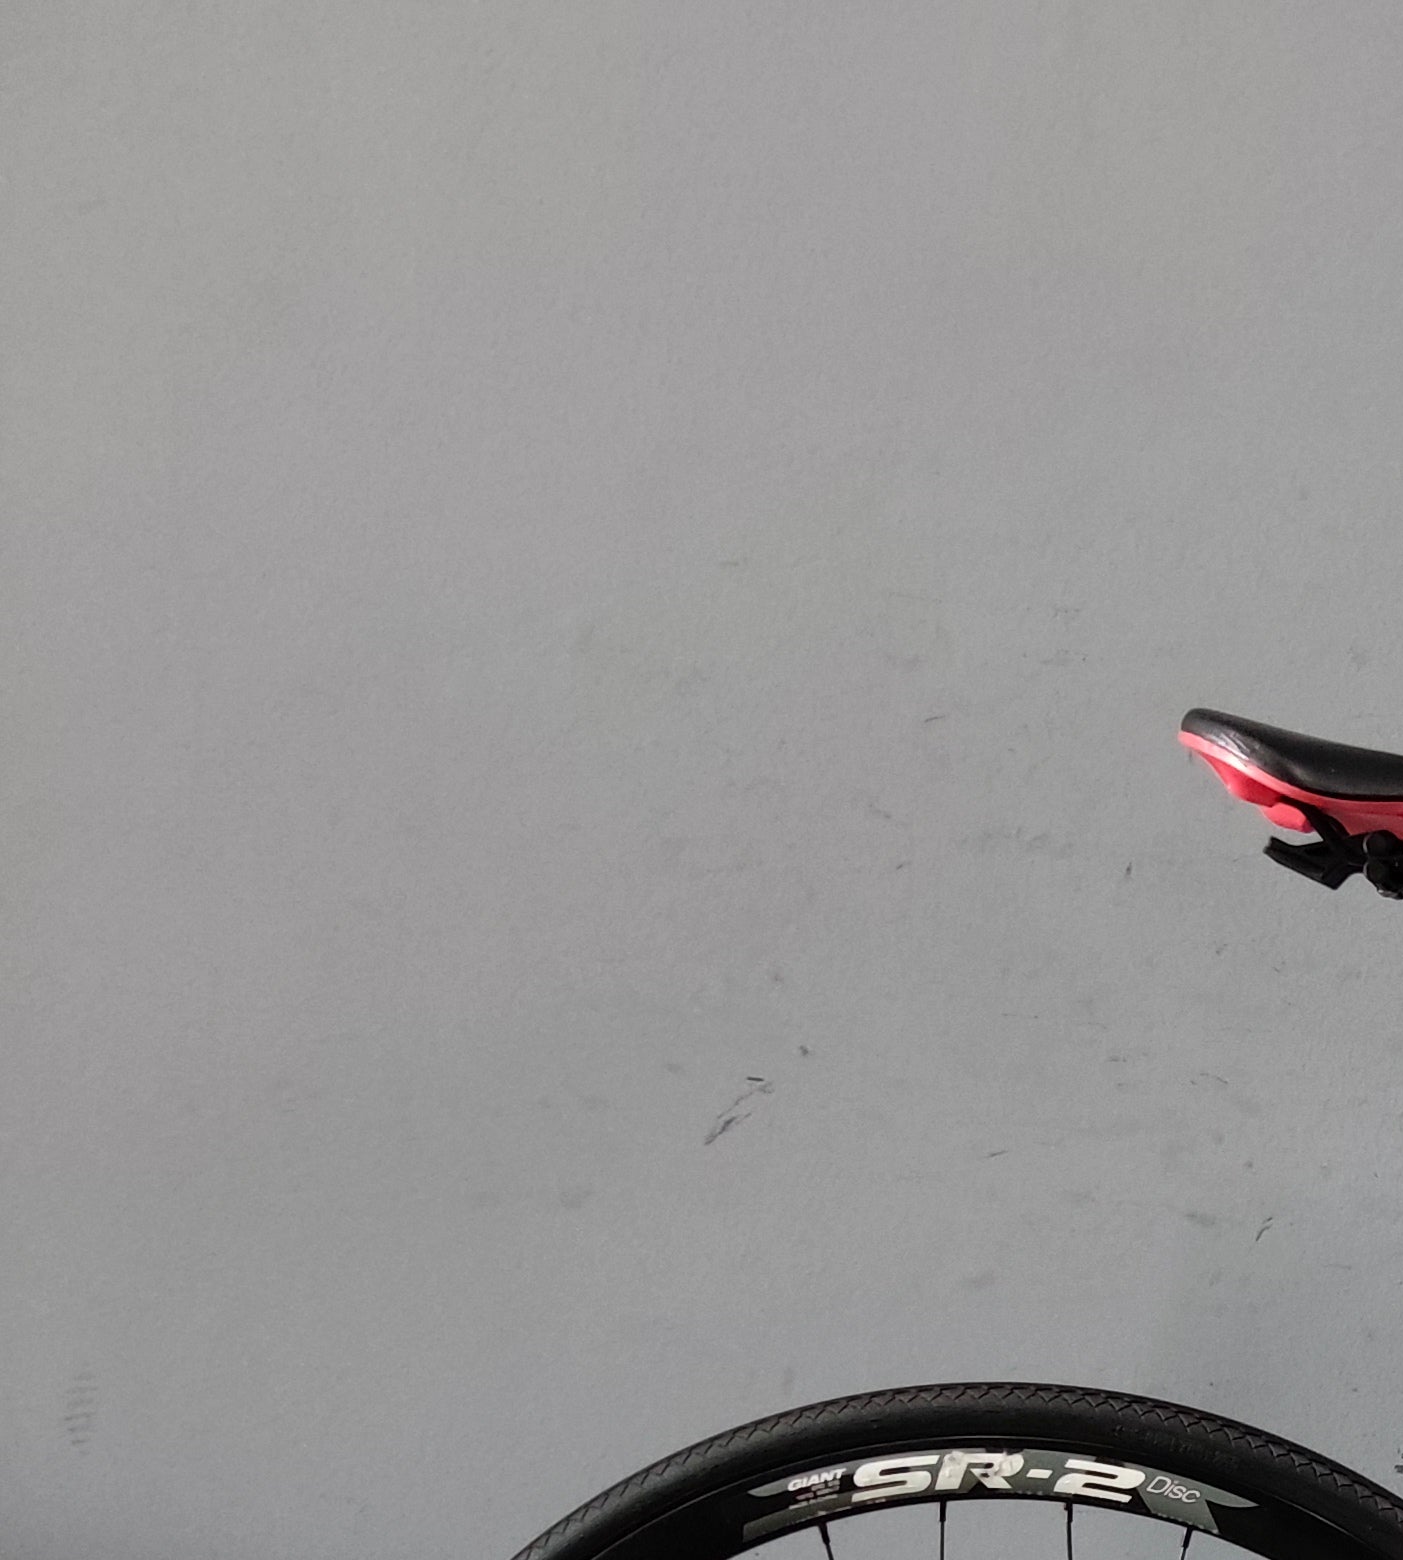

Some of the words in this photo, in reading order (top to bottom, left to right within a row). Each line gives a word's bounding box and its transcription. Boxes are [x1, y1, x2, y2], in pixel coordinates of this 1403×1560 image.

[787, 1468, 847, 1491] GIANT
[852, 1452, 1146, 1502] SR-2
[1145, 1475, 1201, 1504] Disc
